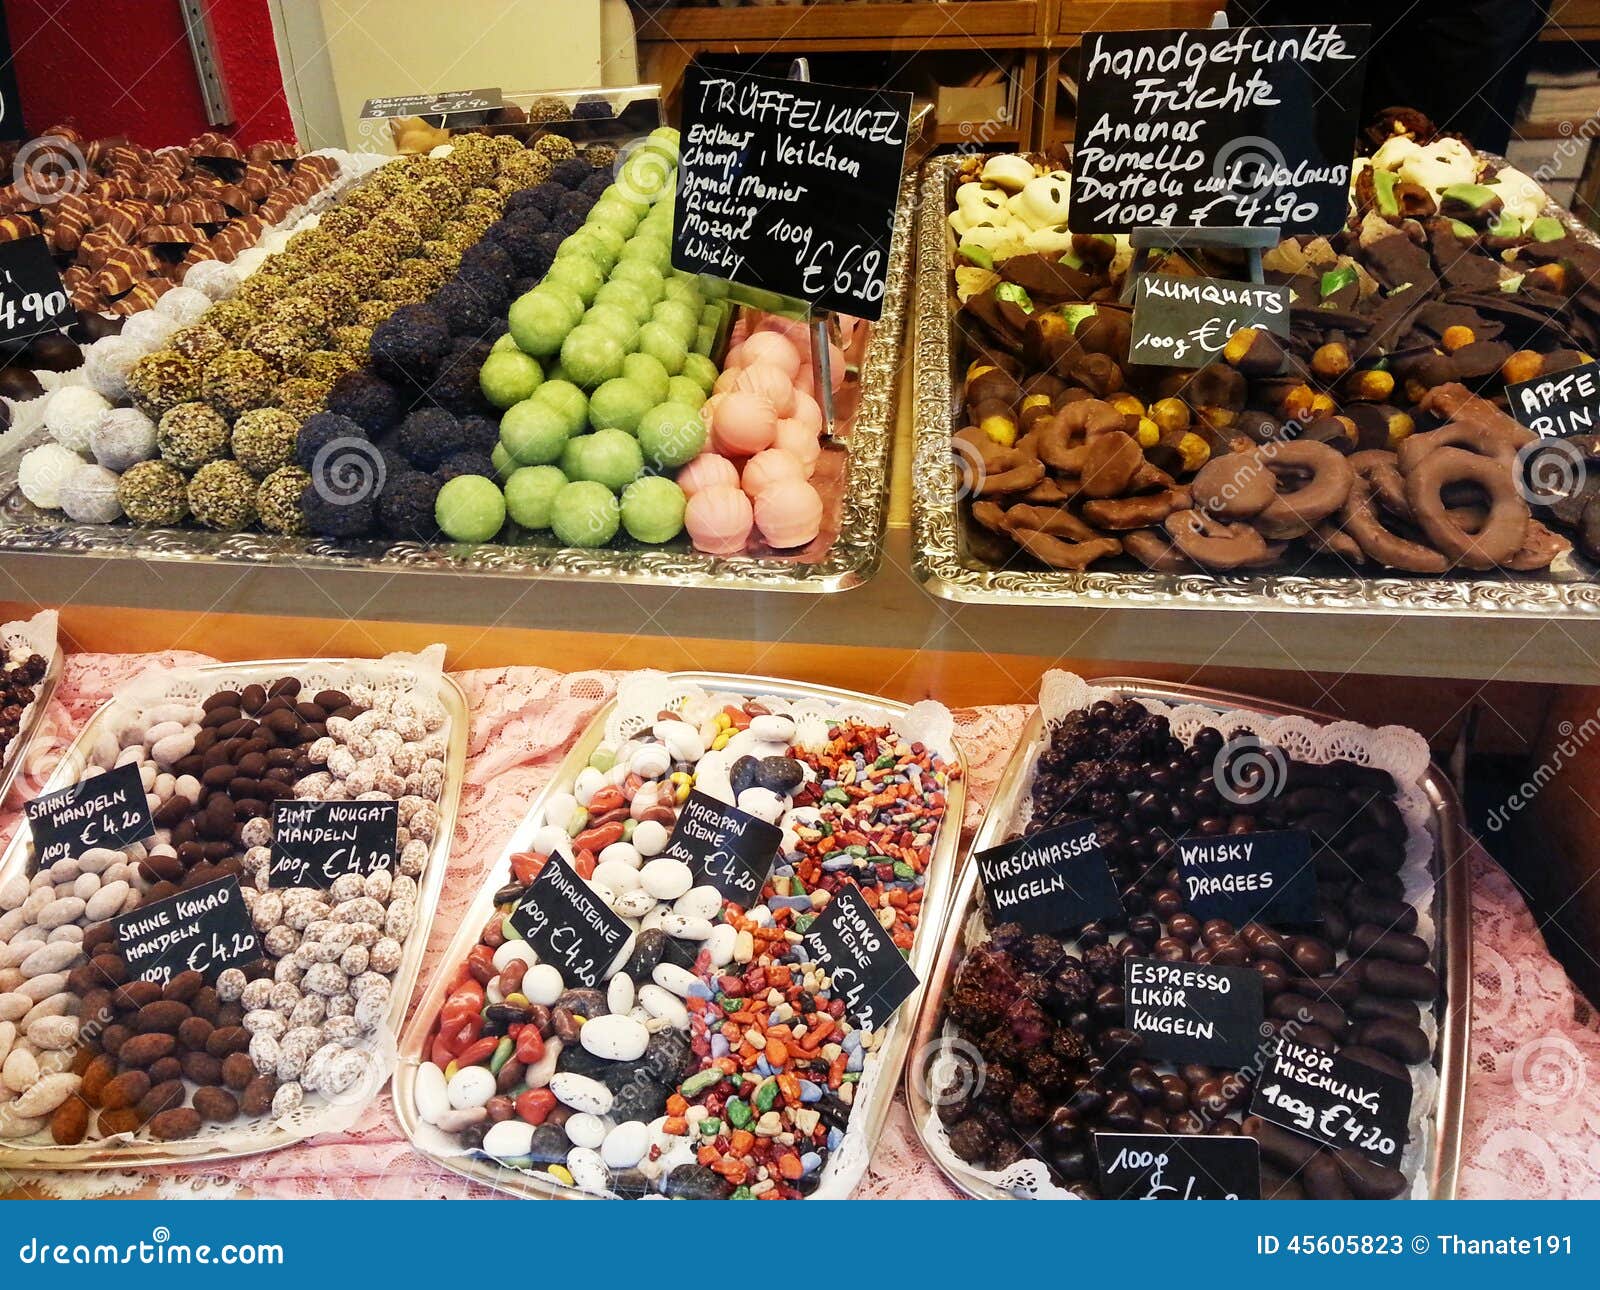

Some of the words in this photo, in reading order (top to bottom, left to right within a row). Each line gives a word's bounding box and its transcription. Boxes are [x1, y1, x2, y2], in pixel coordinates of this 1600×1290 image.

[1084, 112, 1206, 148] Ananas
[1077, 144, 1205, 176] Pomello
[1254, 160, 1349, 188] Walnuss
[686, 191, 758, 223] Riesling
[1094, 202, 1177, 227] 100g
[684, 238, 744, 280] Whisky
[767, 218, 812, 266] 100g
[1144, 277, 1283, 314] KUMQUATS
[1135, 333, 1191, 360] 100g
[1521, 370, 1600, 416] APFE
[1530, 405, 1600, 440] RIN
[30, 789, 76, 820] SAHNE
[52, 789, 127, 828] MANDELN
[278, 807, 316, 824] ZIMT
[328, 806, 394, 822] NOUGAT
[684, 800, 747, 837] MARZIPAN
[277, 825, 358, 845] MANDELN
[683, 819, 725, 847] STEINE
[41, 842, 71, 864] 100g
[270, 856, 310, 884] 100g
[982, 832, 1100, 884] KIRSCHWASSER
[1180, 842, 1254, 867] WHISKY
[541, 860, 620, 943] DONAUSTEINE
[993, 874, 1065, 910] KUGELN
[1186, 871, 1273, 901] DRAGEES
[119, 911, 171, 942] SAHNE
[176, 888, 229, 920] KAKAO
[519, 900, 548, 938] 100g
[837, 894, 881, 952] SCHOKO
[125, 922, 200, 963] MANDELN
[833, 915, 872, 970] STEINE
[1130, 963, 1231, 994] ESPRESSO
[1131, 986, 1187, 1008] LIKÖR
[1133, 1009, 1214, 1039] KUGELN
[1276, 1038, 1334, 1073] LIKÖR
[1274, 1056, 1381, 1115] MISCHUNG
[1262, 1083, 1315, 1129] 100g
[1107, 1147, 1169, 1188] 100g
